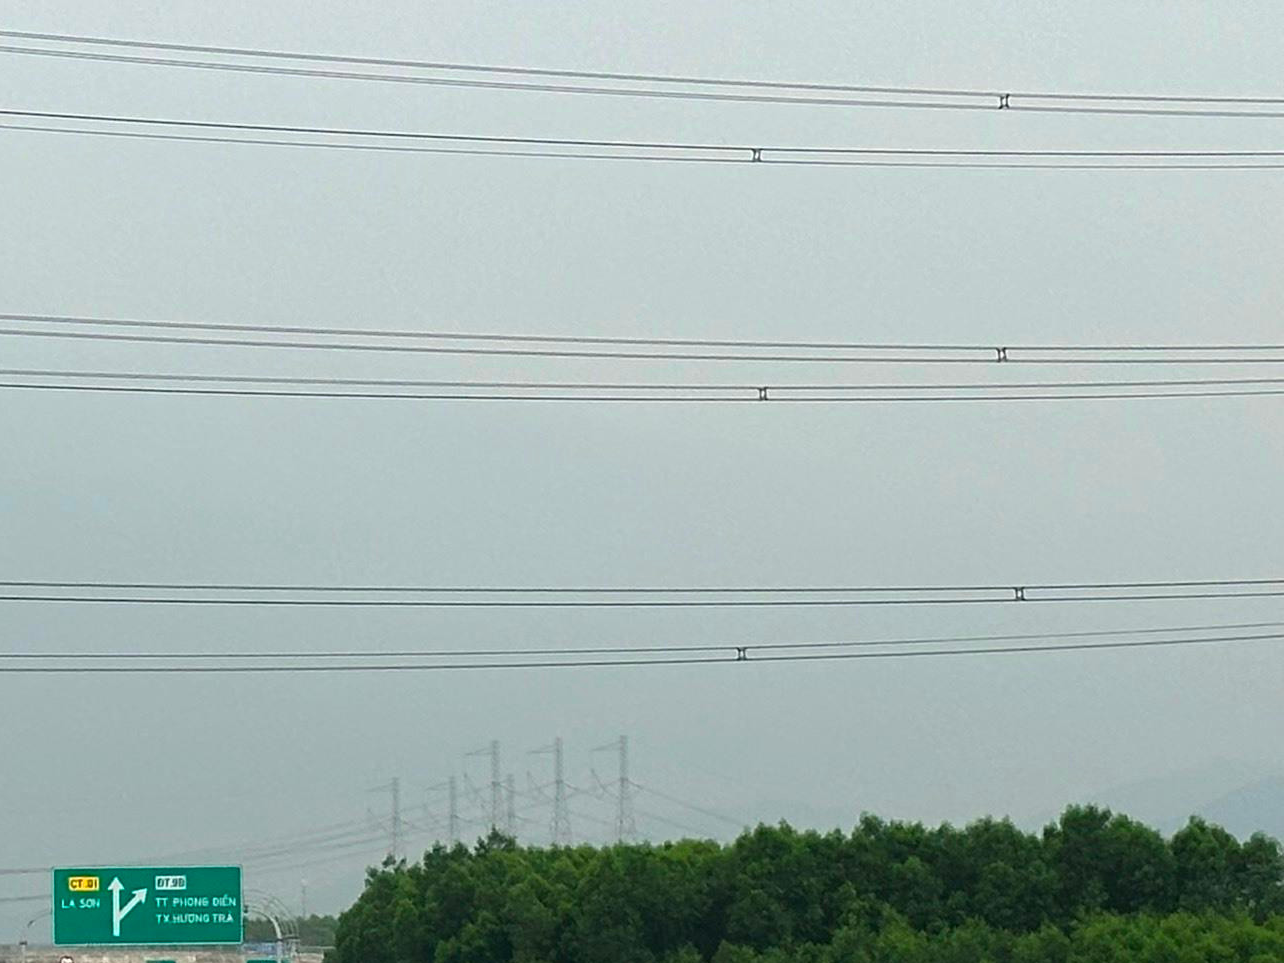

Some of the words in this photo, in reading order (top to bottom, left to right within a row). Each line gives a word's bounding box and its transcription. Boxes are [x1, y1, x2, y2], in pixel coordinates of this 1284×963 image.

[61, 899, 76, 909] LA
[156, 897, 168, 907] TT
[172, 897, 209, 907] PHONG
